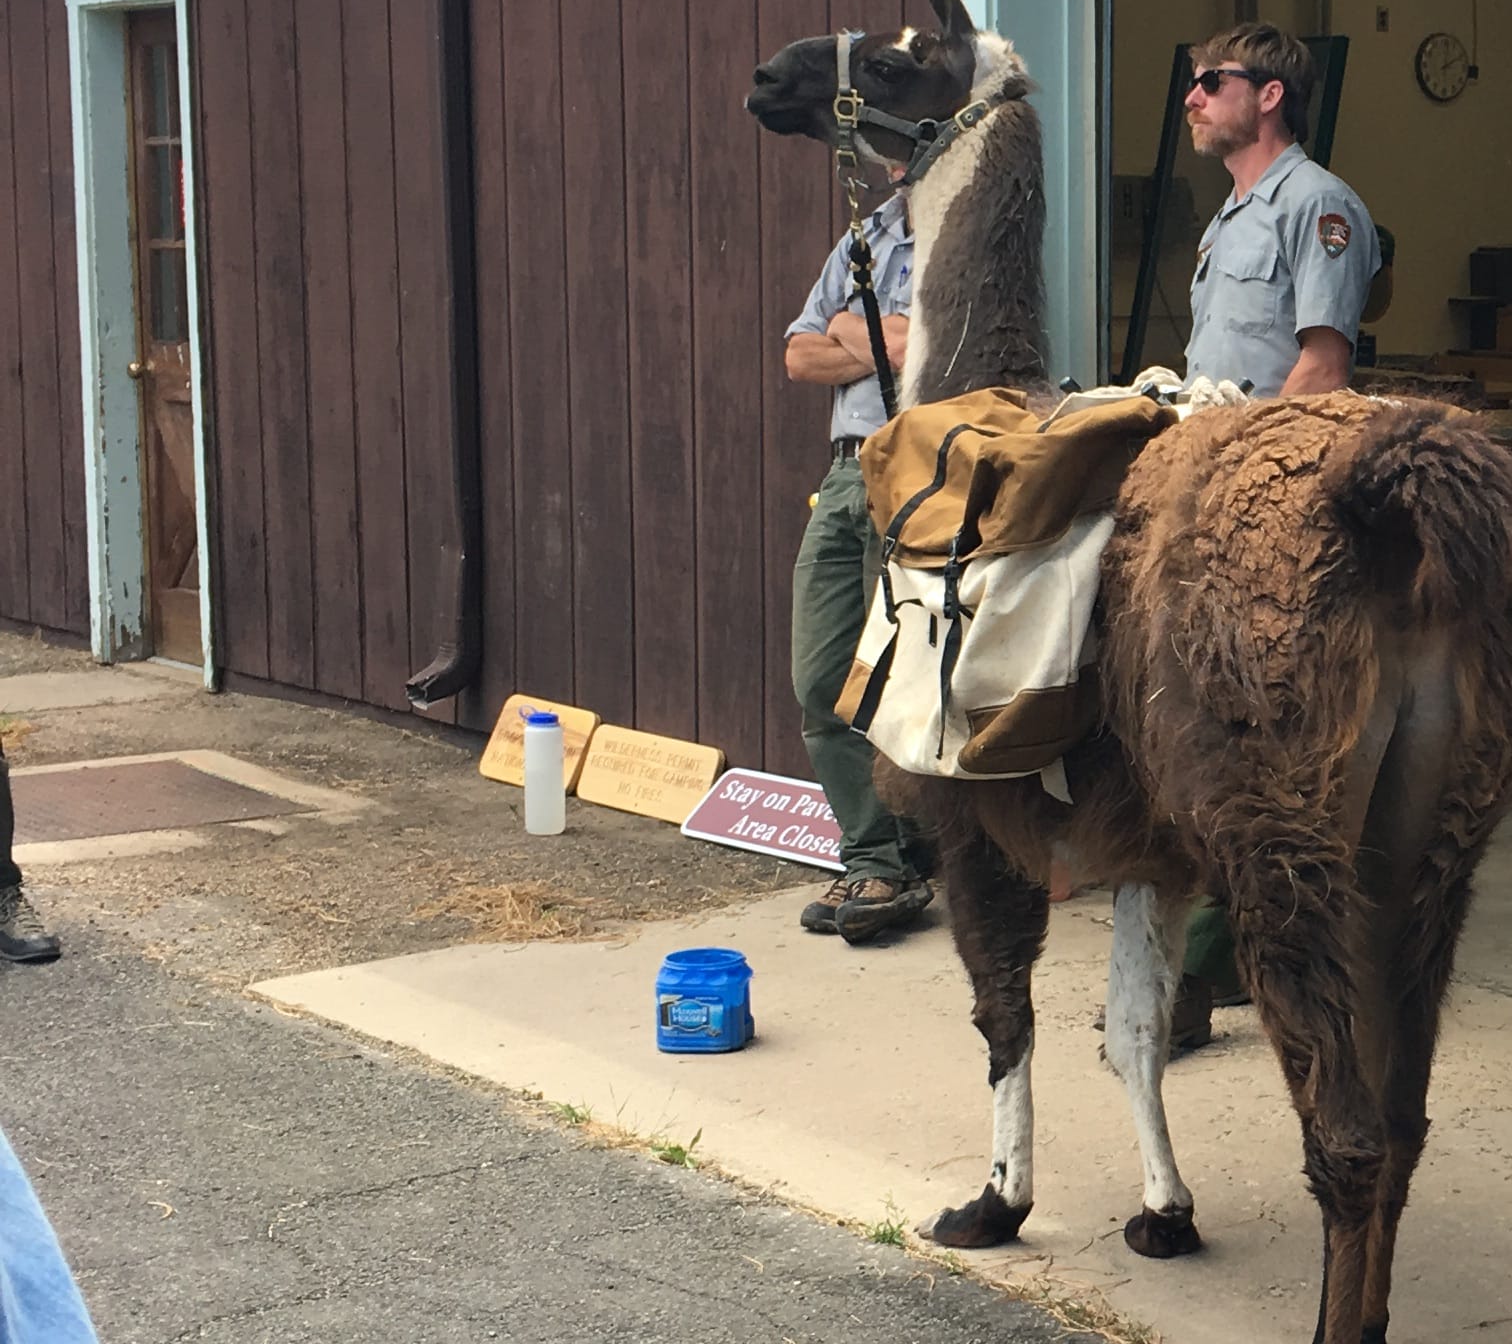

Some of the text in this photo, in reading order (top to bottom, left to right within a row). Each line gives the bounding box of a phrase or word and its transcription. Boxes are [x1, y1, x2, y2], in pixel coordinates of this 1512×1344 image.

[665, 752, 702, 771] PERMIT
[617, 781, 631, 796] NO
[719, 779, 838, 823] Stay on Pave
[727, 814, 778, 842] Area
